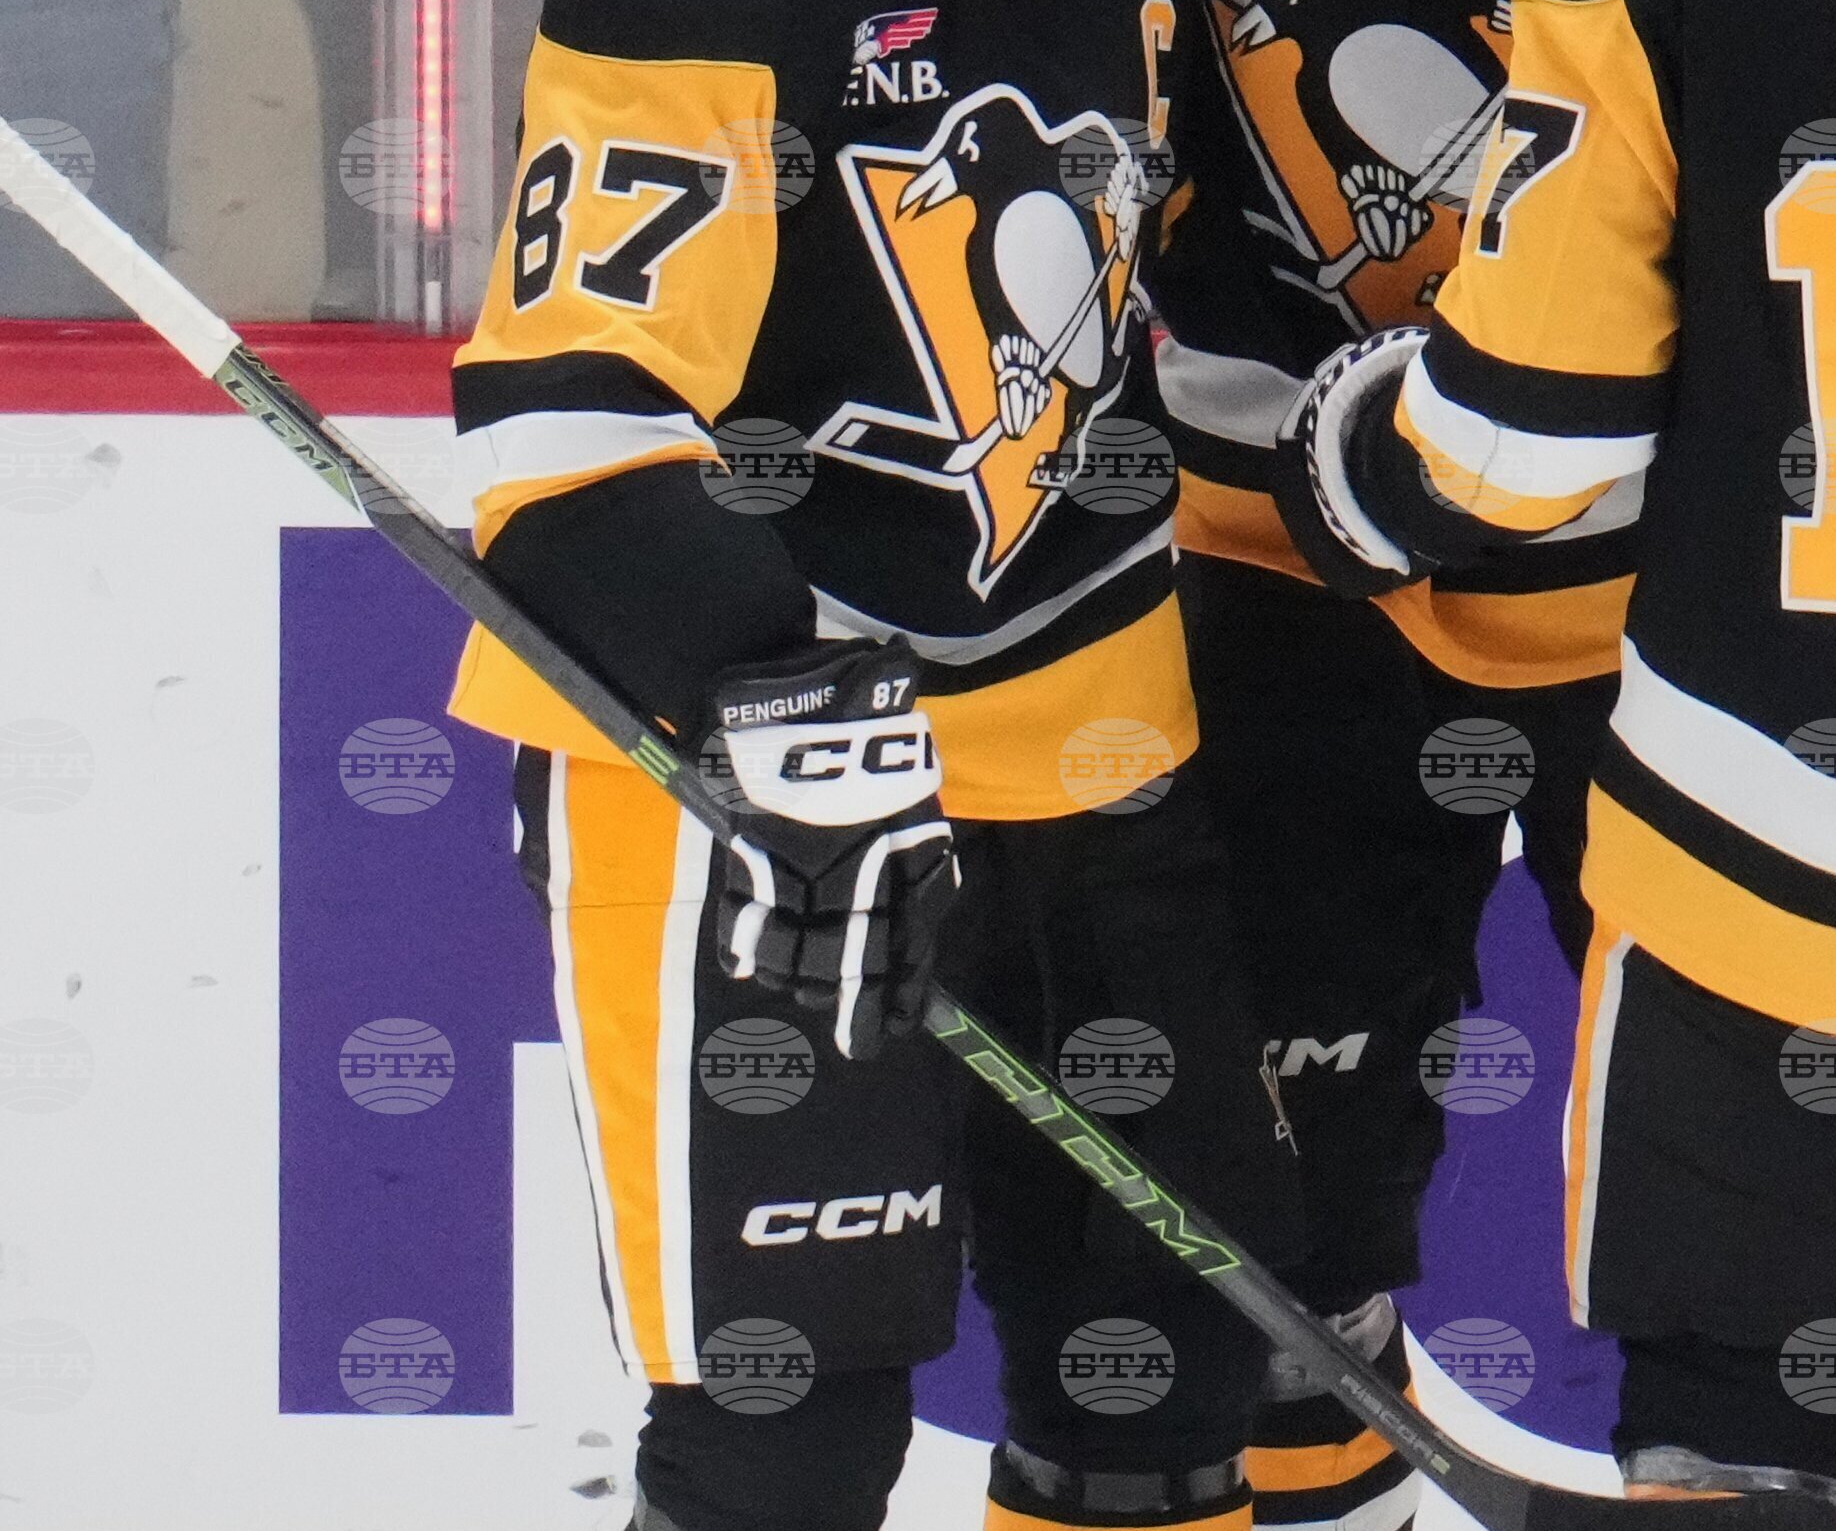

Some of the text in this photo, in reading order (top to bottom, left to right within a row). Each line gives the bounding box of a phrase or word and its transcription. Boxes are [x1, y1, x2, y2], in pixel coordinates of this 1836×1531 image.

[512, 135, 737, 315] 87
[723, 677, 911, 725] PENGUINS 87
[779, 730, 934, 782] CC
[936, 1007, 1242, 1276] CCM
[740, 1183, 943, 1248] CCM
